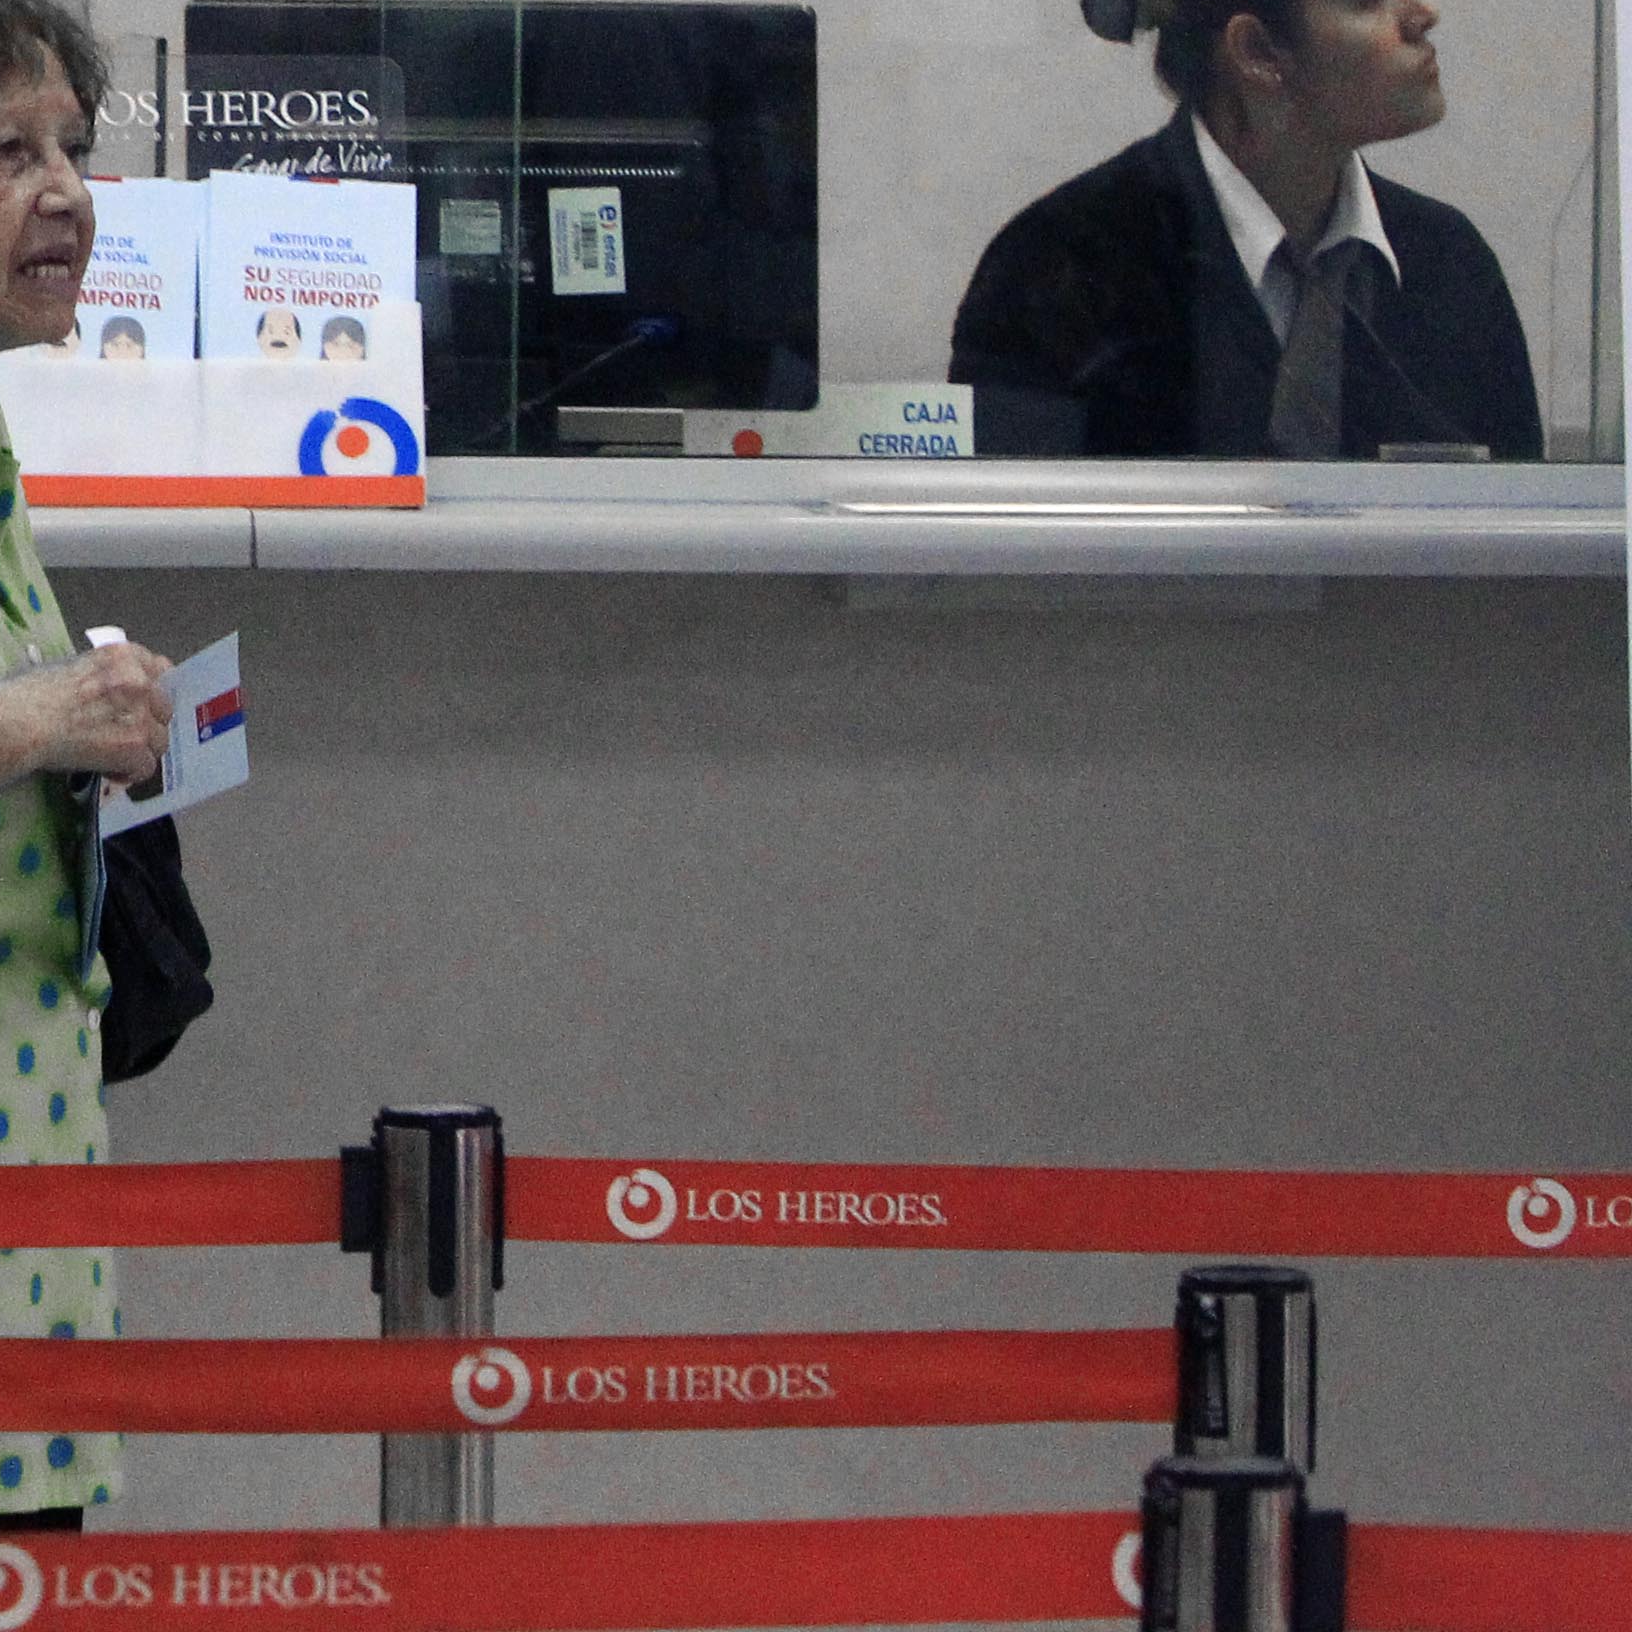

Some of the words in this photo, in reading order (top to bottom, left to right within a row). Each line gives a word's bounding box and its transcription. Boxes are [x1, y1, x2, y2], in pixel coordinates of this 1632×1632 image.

[98, 90, 160, 127] OS
[304, 146, 335, 174] de
[270, 231, 334, 247] INSTITUTO
[337, 237, 352, 249] DE
[323, 252, 368, 265] SOCIAL
[244, 265, 271, 283] SU
[276, 267, 383, 290] SEGURIDAD
[77, 289, 162, 310] MPORTA
[244, 285, 286, 303] NOS
[903, 401, 957, 423] CAJA
[859, 432, 958, 456] CERRADA
[686, 1190, 763, 1223] LOS
[1585, 1195, 1632, 1228] LO
[542, 1366, 628, 1403] LOS
[54, 1567, 154, 1608] LOS
